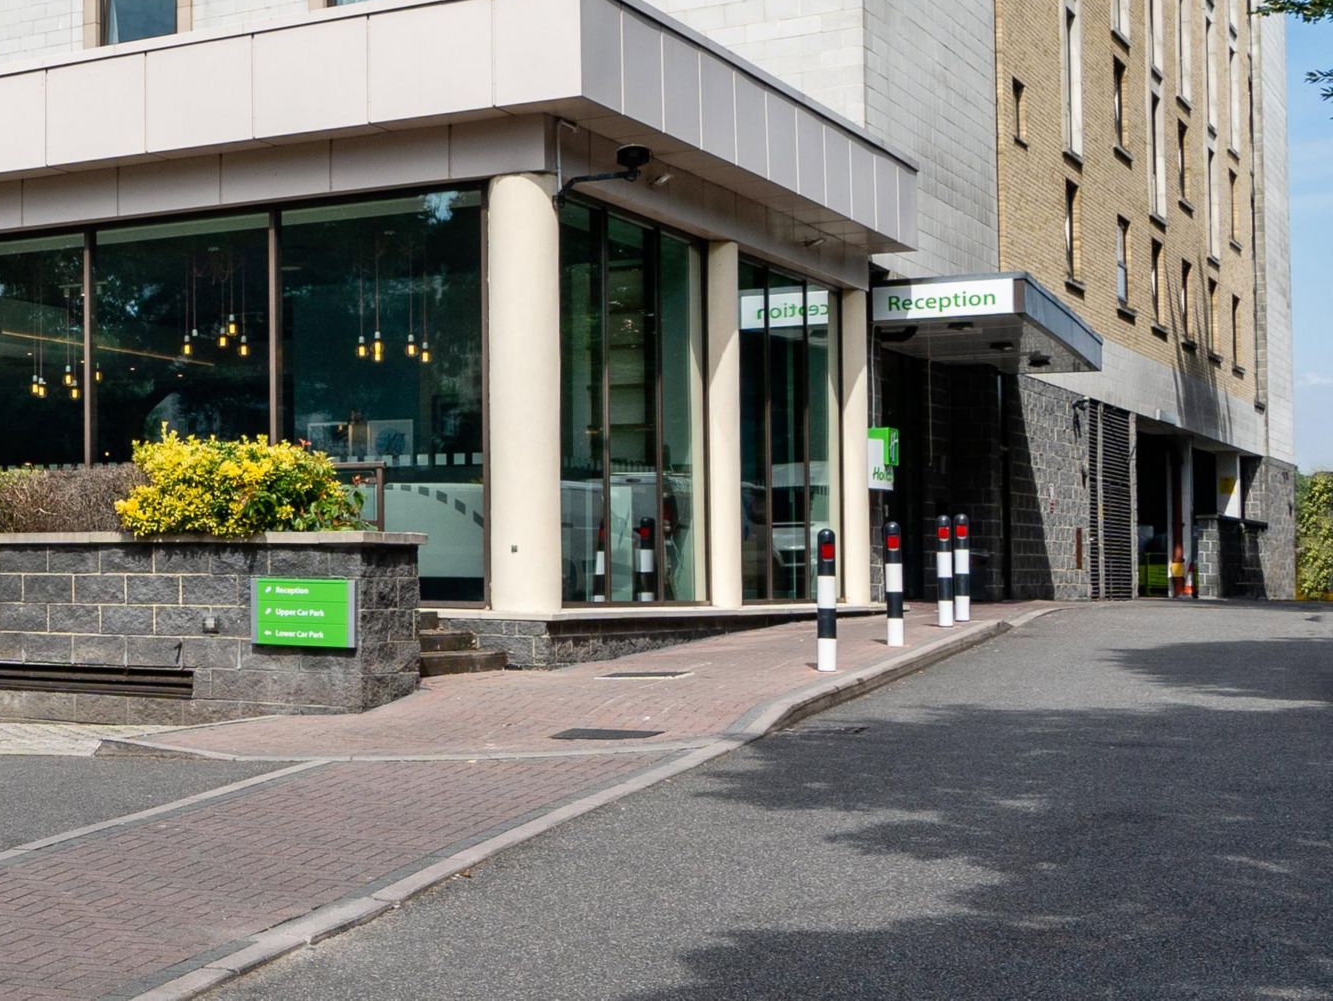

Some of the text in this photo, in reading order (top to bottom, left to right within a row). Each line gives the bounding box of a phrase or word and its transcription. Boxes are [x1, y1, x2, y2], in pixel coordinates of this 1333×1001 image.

[887, 291, 996, 312] Reception
[275, 586, 309, 595] Reception
[275, 608, 325, 617] Upper Car Park
[309, 631, 324, 639] Park
